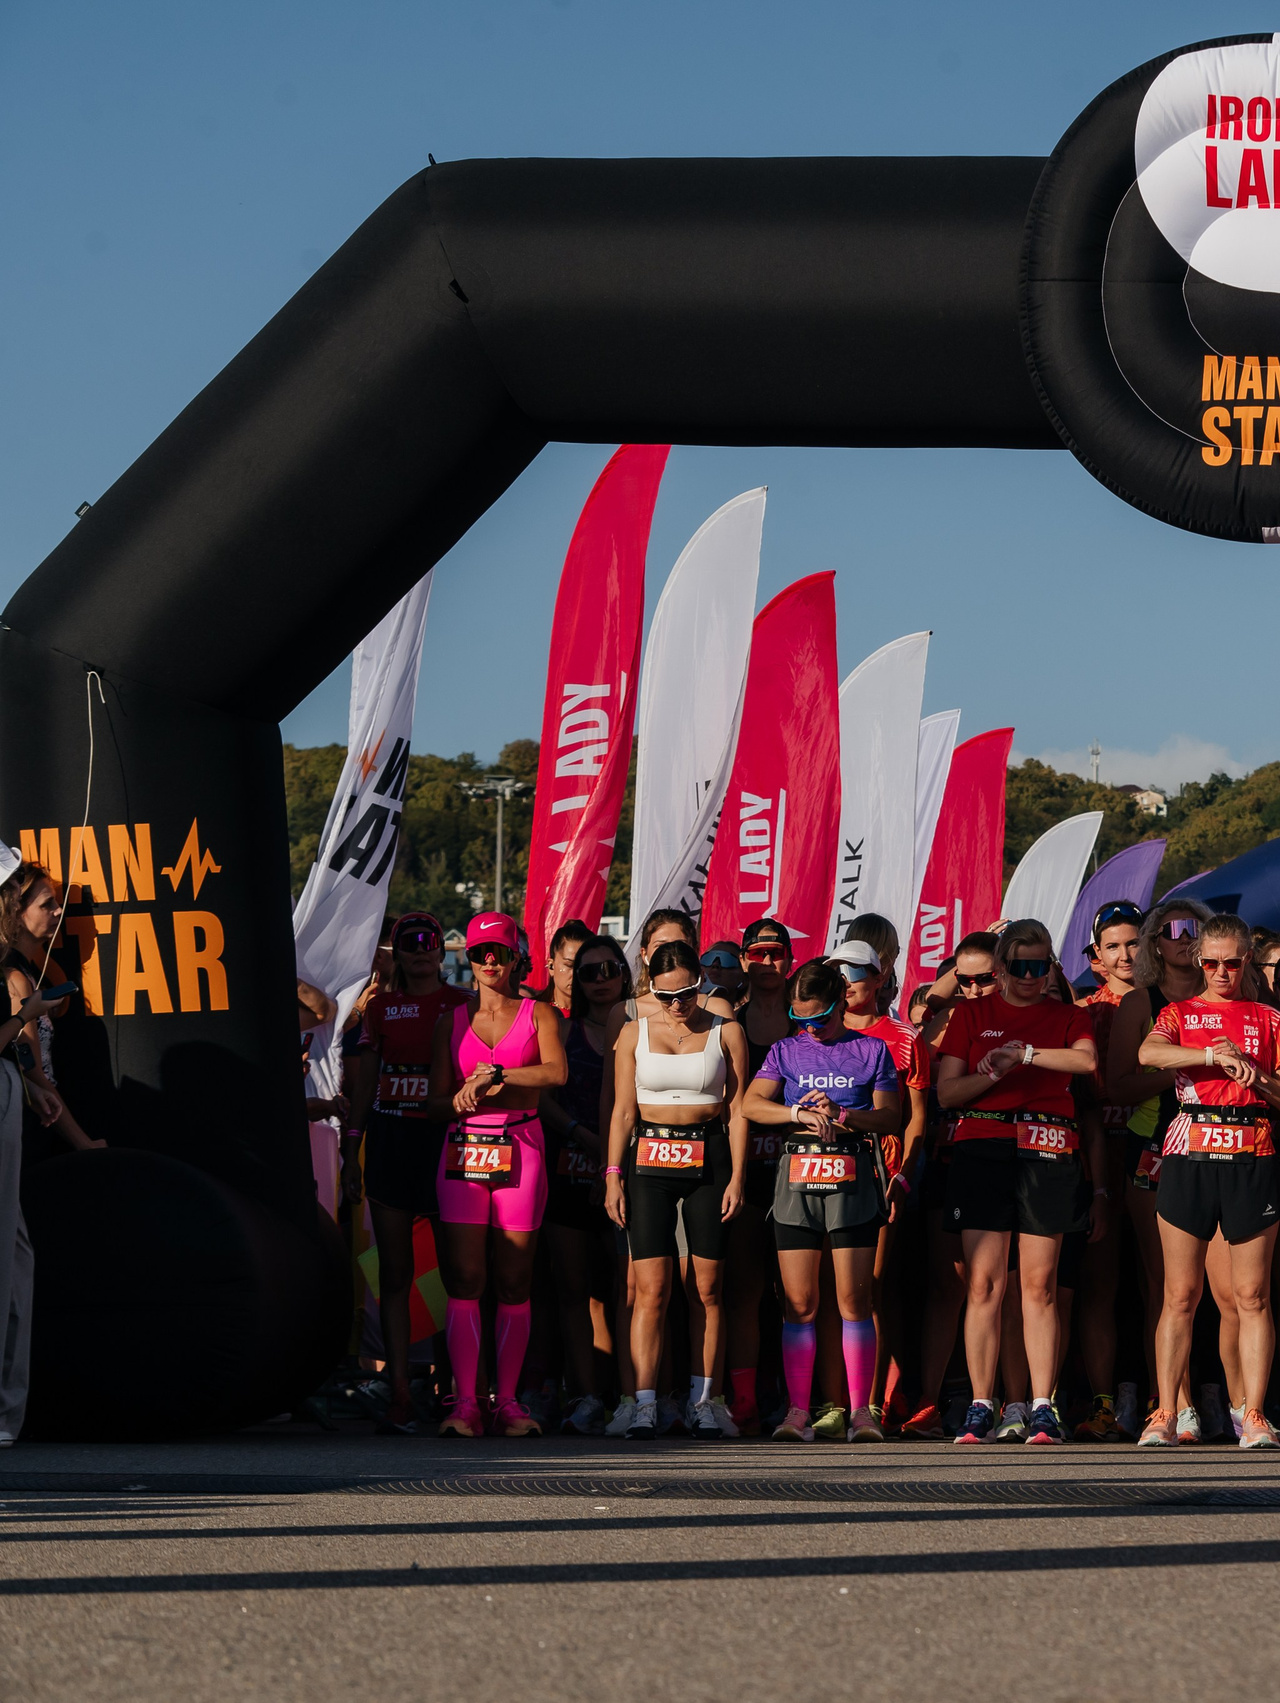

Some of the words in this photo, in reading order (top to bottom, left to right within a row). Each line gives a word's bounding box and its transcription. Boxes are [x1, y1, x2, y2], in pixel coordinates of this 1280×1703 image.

[738, 791, 773, 903] LADY
[19, 823, 156, 904] MAN
[919, 903, 947, 970] ADY
[385, 1006, 399, 1016] 10
[1184, 1014, 1199, 1025] 10
[1243, 1029, 1260, 1037] LADY
[389, 1076, 430, 1097] 7173
[798, 1072, 855, 1089] Haier
[1028, 1125, 1066, 1149] 7395
[1201, 1127, 1244, 1149] 7531
[457, 1146, 501, 1168] 7274
[648, 1141, 694, 1164] 7852
[1209, 1153, 1234, 1161] ЕВГЕНИЯ
[800, 1157, 846, 1178] 7758
